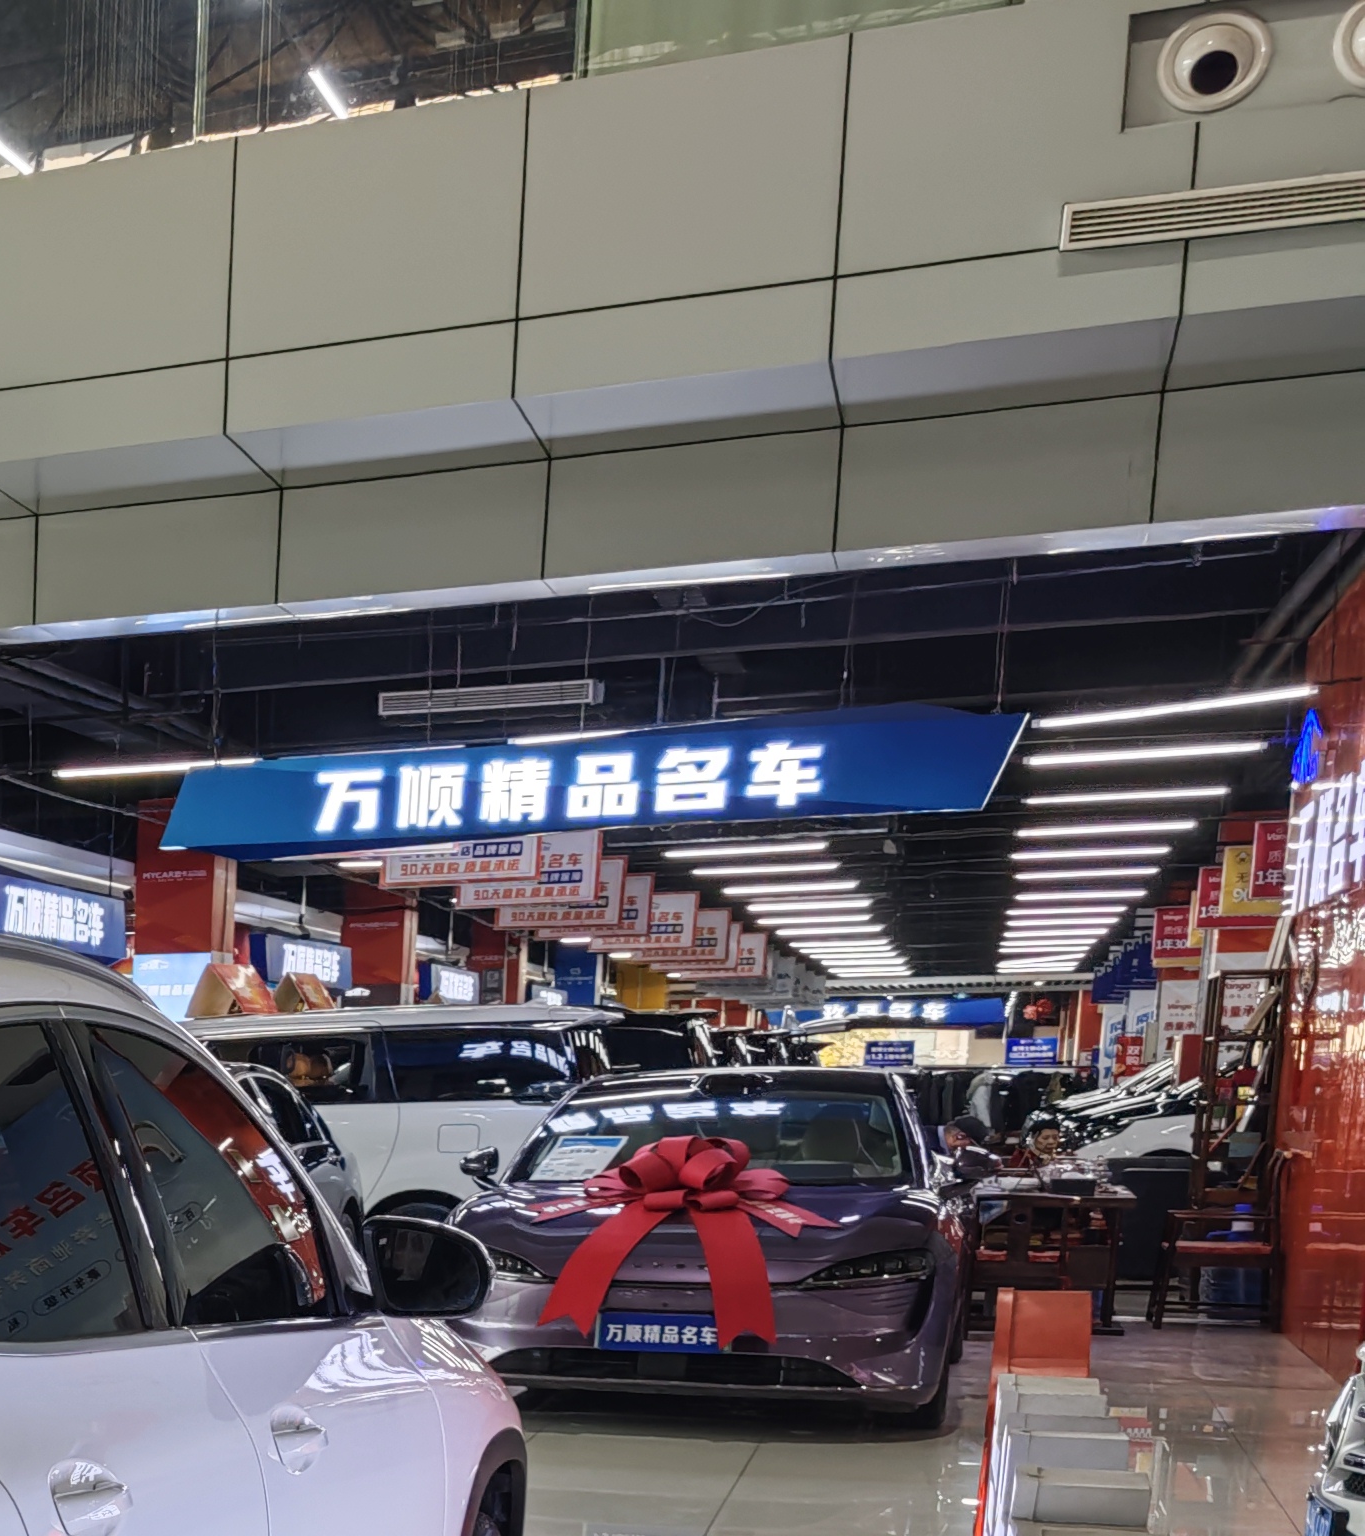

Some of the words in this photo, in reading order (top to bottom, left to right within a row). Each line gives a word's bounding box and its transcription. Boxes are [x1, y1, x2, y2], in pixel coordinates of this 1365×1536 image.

[314, 740, 825, 833] 万顺精品名车
[606, 1324, 718, 1345] 万顺精品名车
